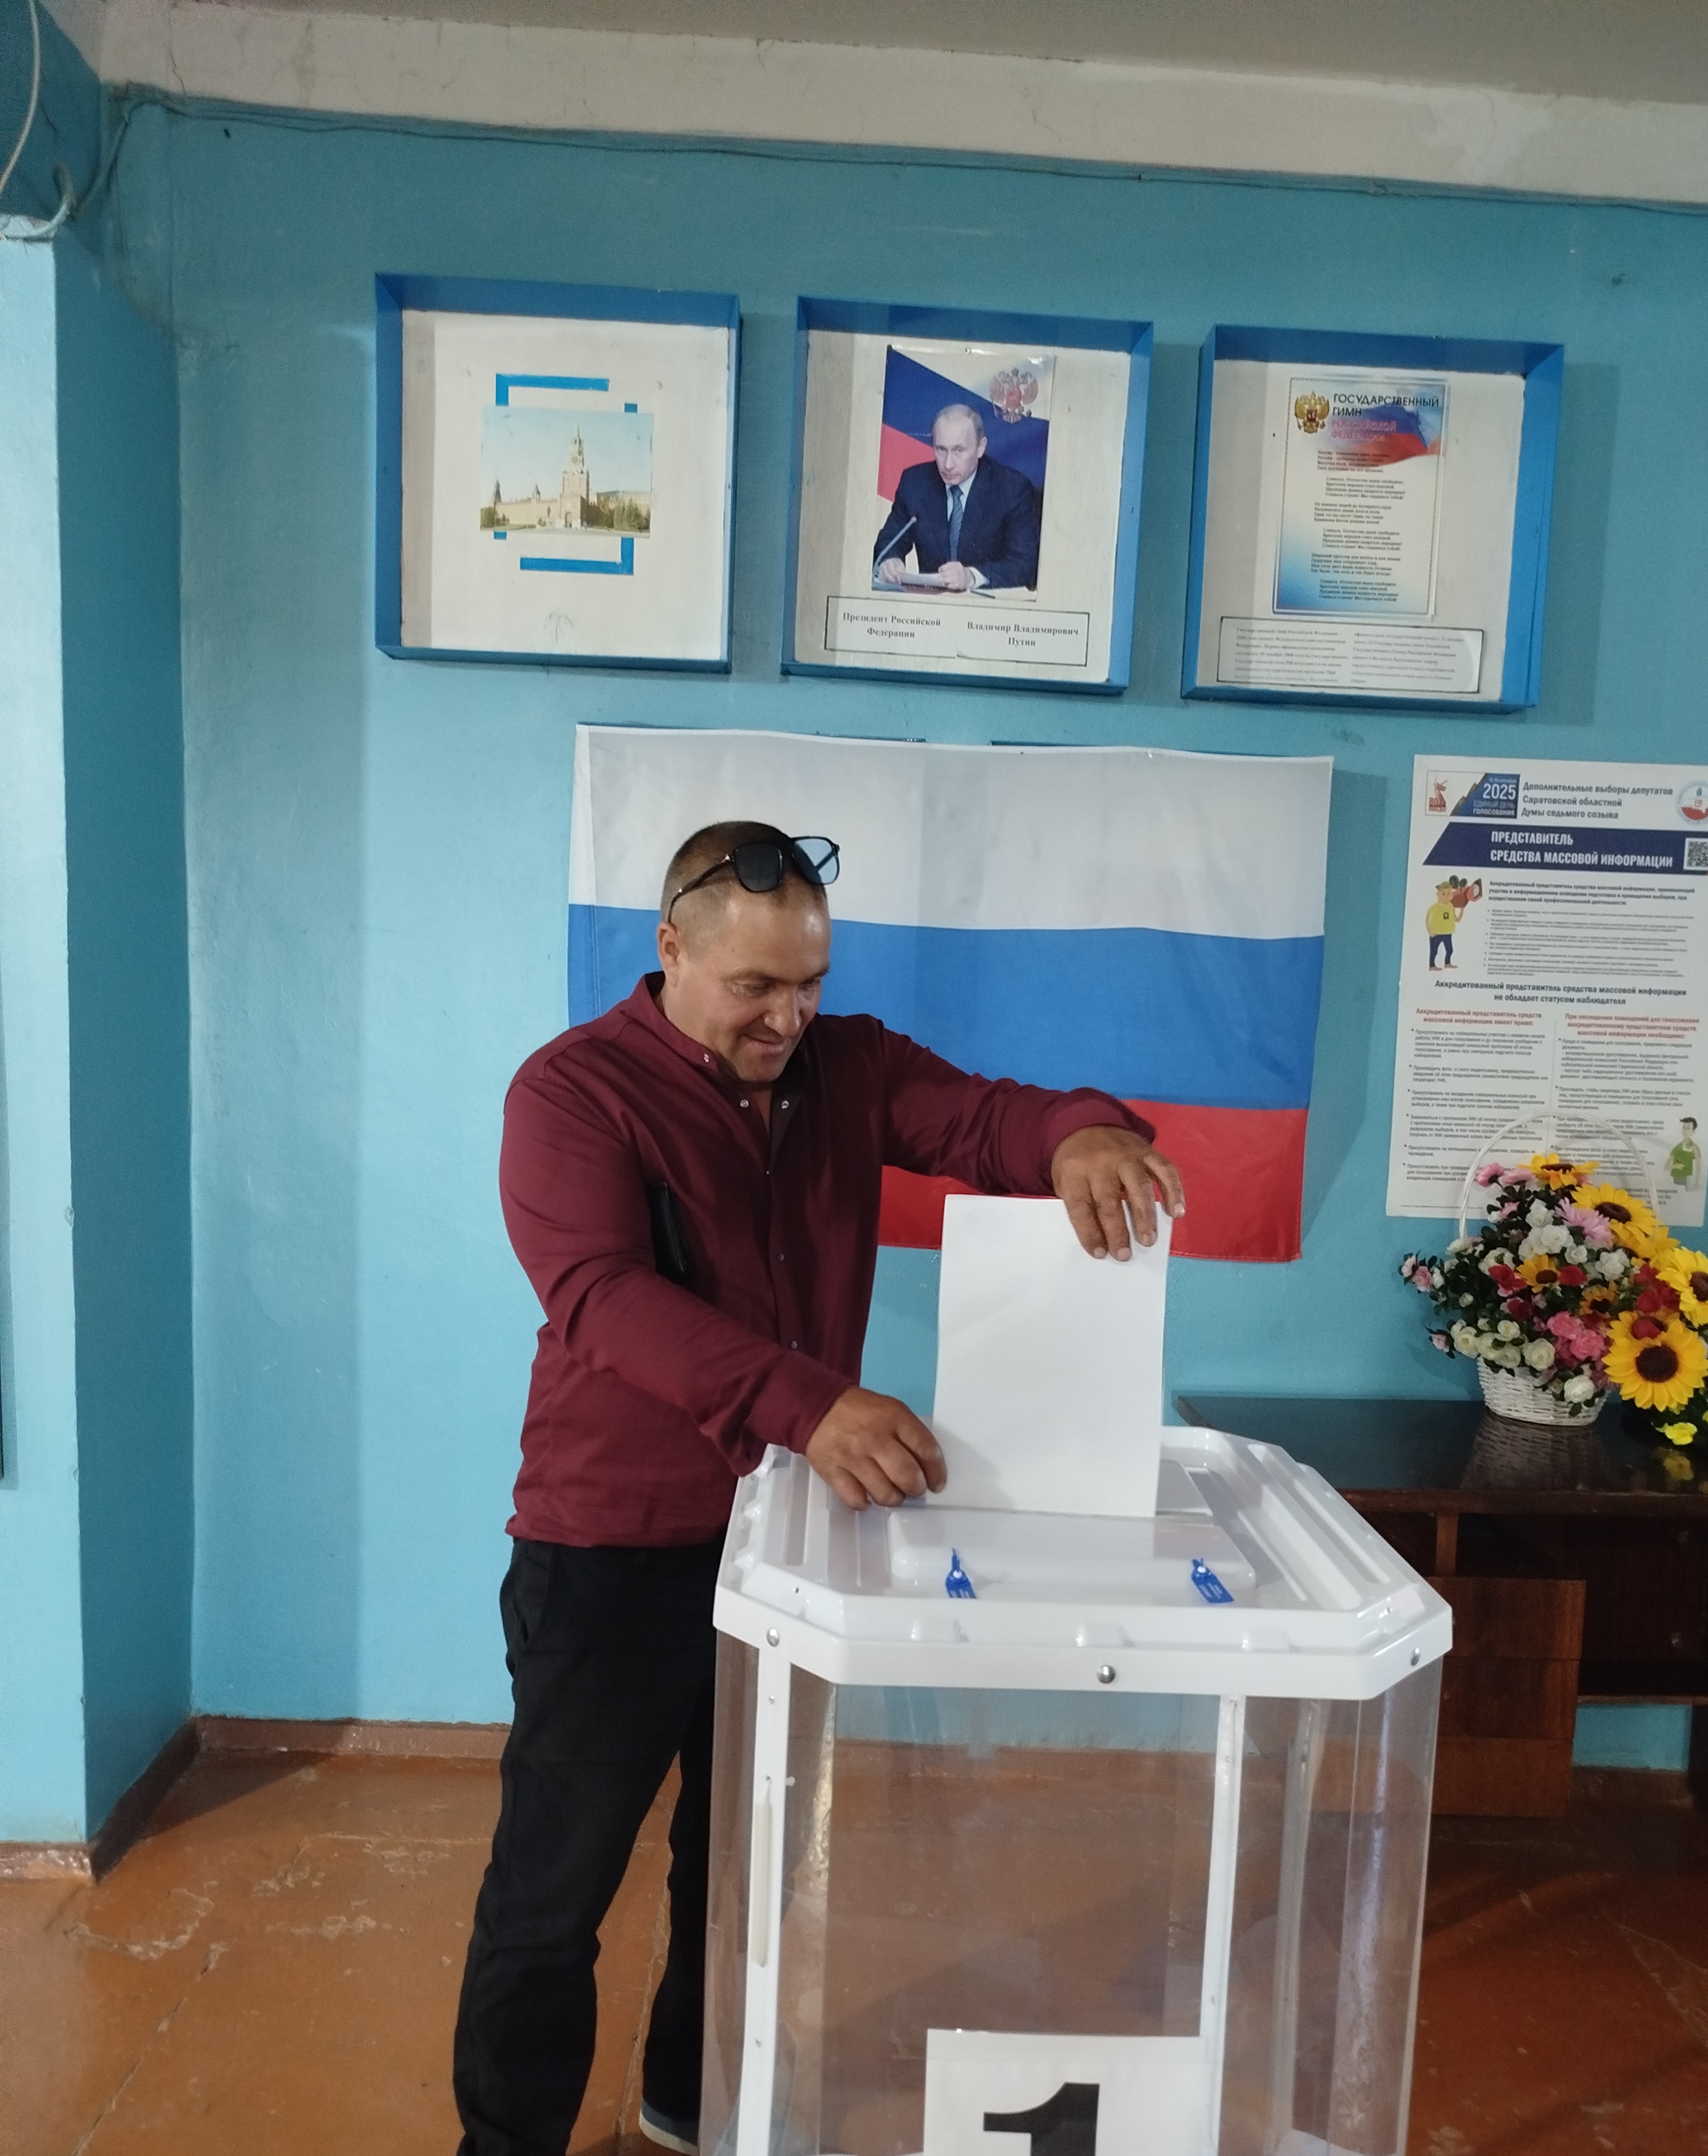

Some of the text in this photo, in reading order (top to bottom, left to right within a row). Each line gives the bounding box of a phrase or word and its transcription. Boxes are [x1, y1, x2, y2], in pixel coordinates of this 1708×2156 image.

[1334, 393, 1439, 407] ГОСУДАРСТВЕННЫЙ
[1332, 407, 1362, 416] ГИМН
[1332, 420, 1397, 431] РОССИЙСКОЙ
[843, 612, 941, 626] Президент Российской
[867, 627, 915, 638] Федерации
[967, 621, 1079, 636] Владимир Владимирович
[1008, 637, 1036, 648] Путин
[1482, 783, 1516, 800] 2025
[1523, 782, 1673, 796] Дополнительные выборы депутатов
[1523, 795, 1622, 806] Саратовской областной
[1521, 808, 1544, 818] Думы
[1547, 810, 1585, 819] седьмого
[1491, 831, 1573, 845] ПРЕДСТАВИТЕЛЬ
[1490, 849, 1673, 868] СРЕДСТВА МАССОВОЙ ИНФОРМАЦИИ
[1435, 980, 1504, 990] Аккредитованный
[1638, 986, 1687, 996] информации
[1505, 993, 1538, 1003] обладает
[1540, 996, 1575, 1004] статусом
[1577, 995, 1626, 1005] наблюдателя
